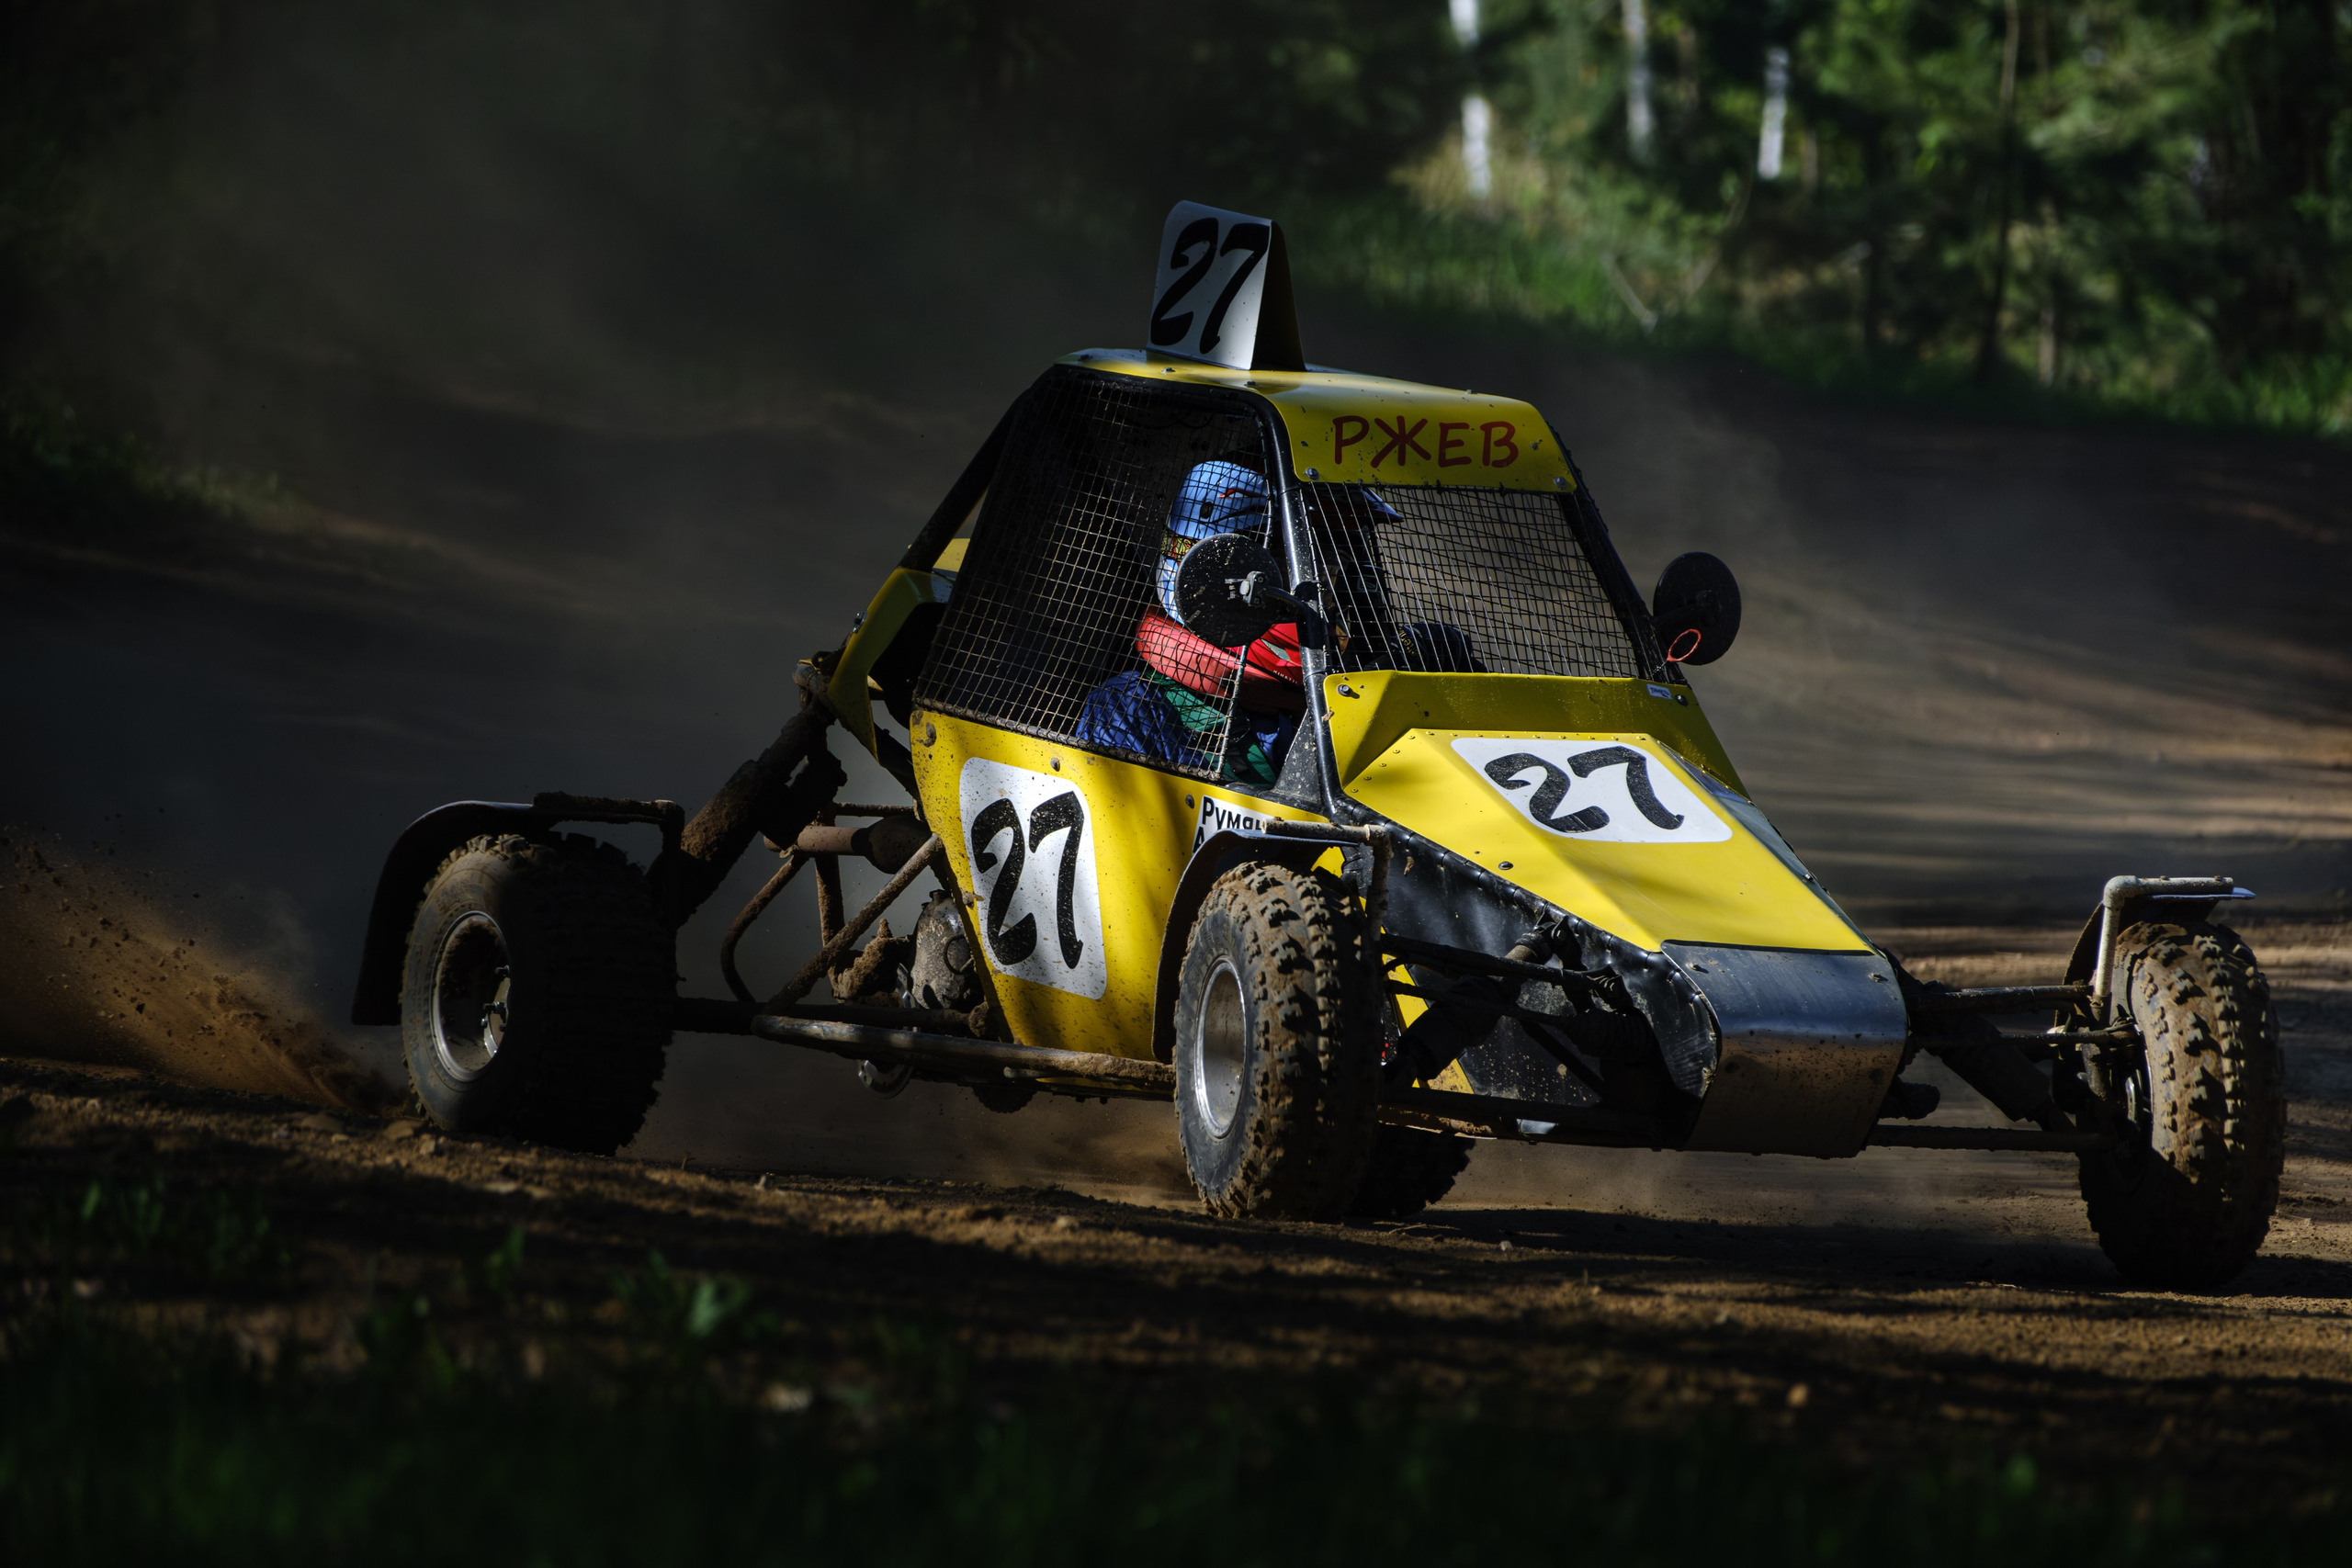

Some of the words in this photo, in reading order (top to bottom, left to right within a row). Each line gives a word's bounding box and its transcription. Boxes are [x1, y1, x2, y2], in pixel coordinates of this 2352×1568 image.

[1150, 218, 1270, 354] 27
[1332, 415, 1519, 468] РЖЕВ
[1484, 745, 1685, 833] 27
[971, 791, 1084, 969] 27
